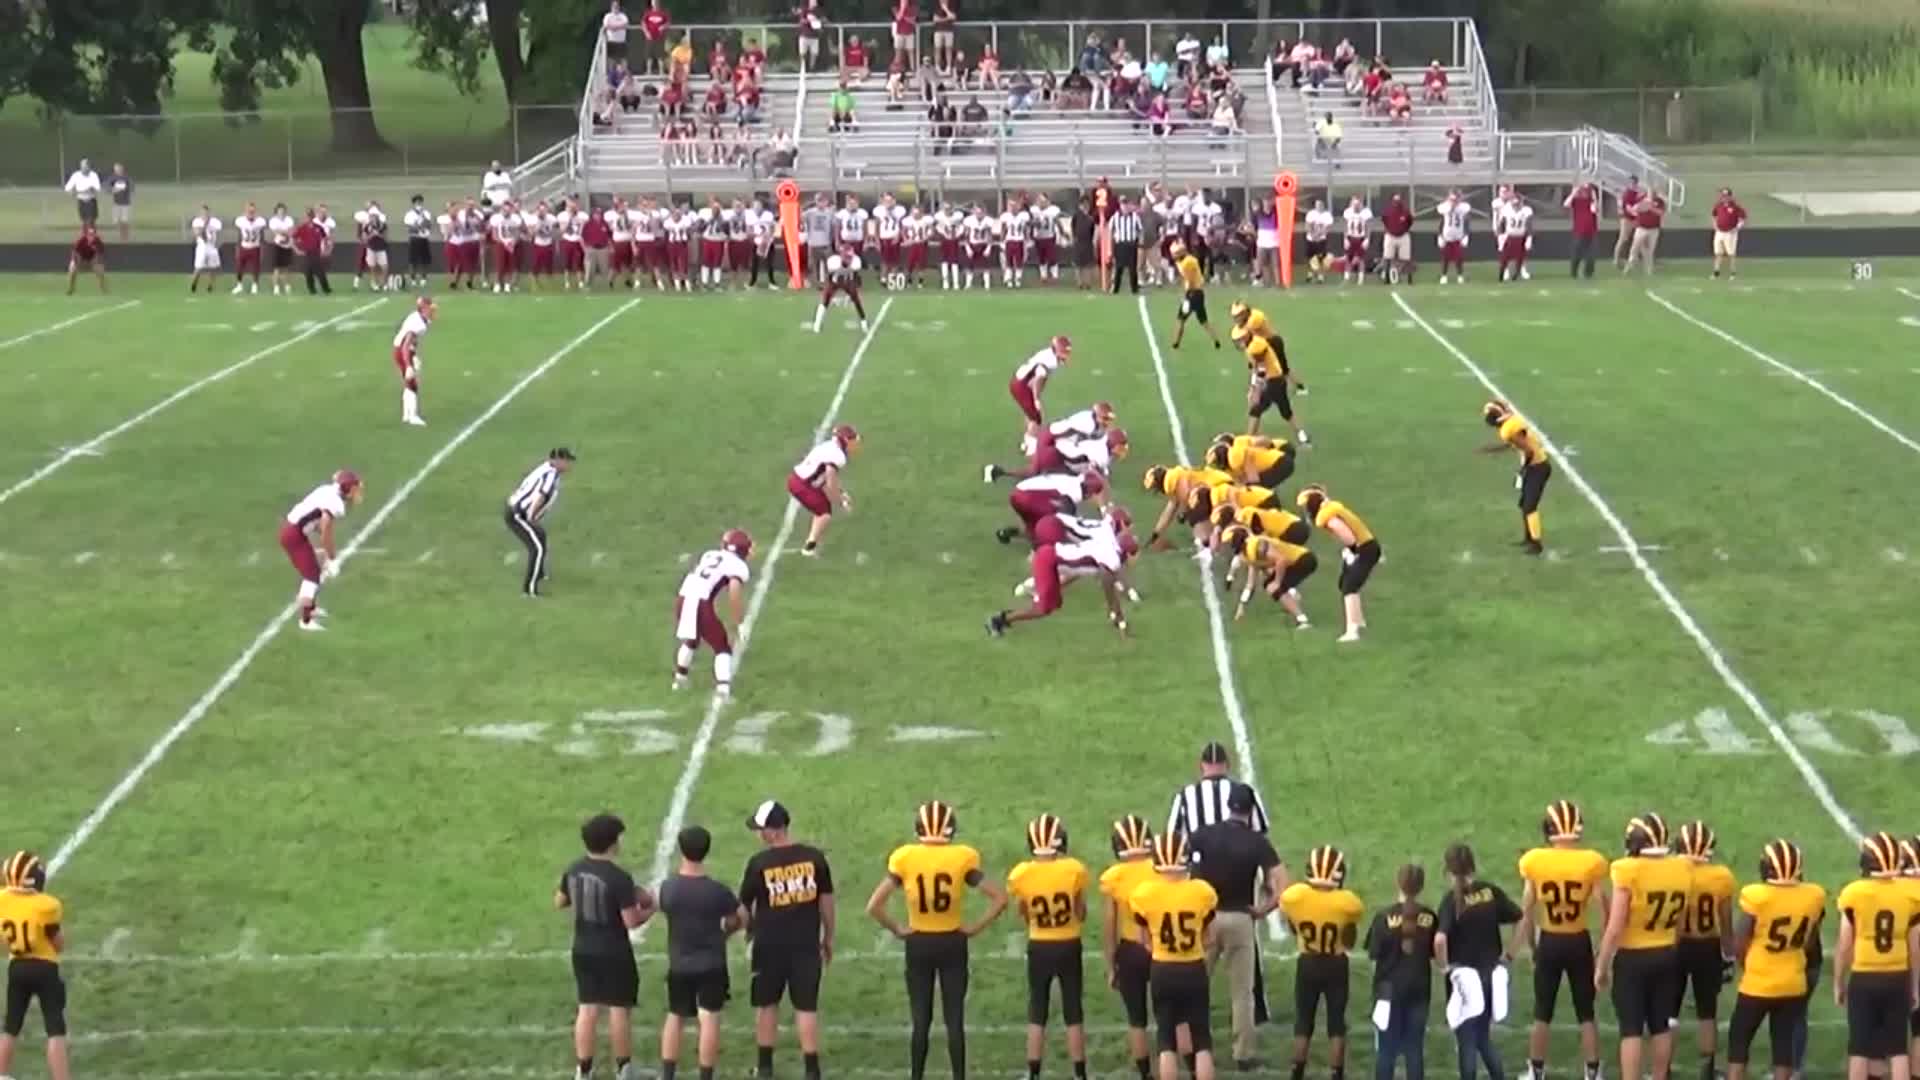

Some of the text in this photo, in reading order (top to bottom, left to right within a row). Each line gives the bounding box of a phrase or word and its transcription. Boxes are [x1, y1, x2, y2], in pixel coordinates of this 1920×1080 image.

[888, 273, 906, 290] 50
[1854, 263, 1872, 281] 30
[554, 708, 855, 757] 50
[1645, 707, 1920, 757] 40
[764, 862, 815, 881] PROUD
[916, 872, 954, 914] 16
[1032, 892, 1073, 929] 22
[1541, 880, 1583, 925] 25
[1644, 890, 1687, 931] 72
[1, 918, 32, 956] 21
[1159, 911, 1197, 953] 45
[1299, 921, 1339, 955] 20
[1766, 915, 1811, 953] 54
[1874, 909, 1895, 953] 8
